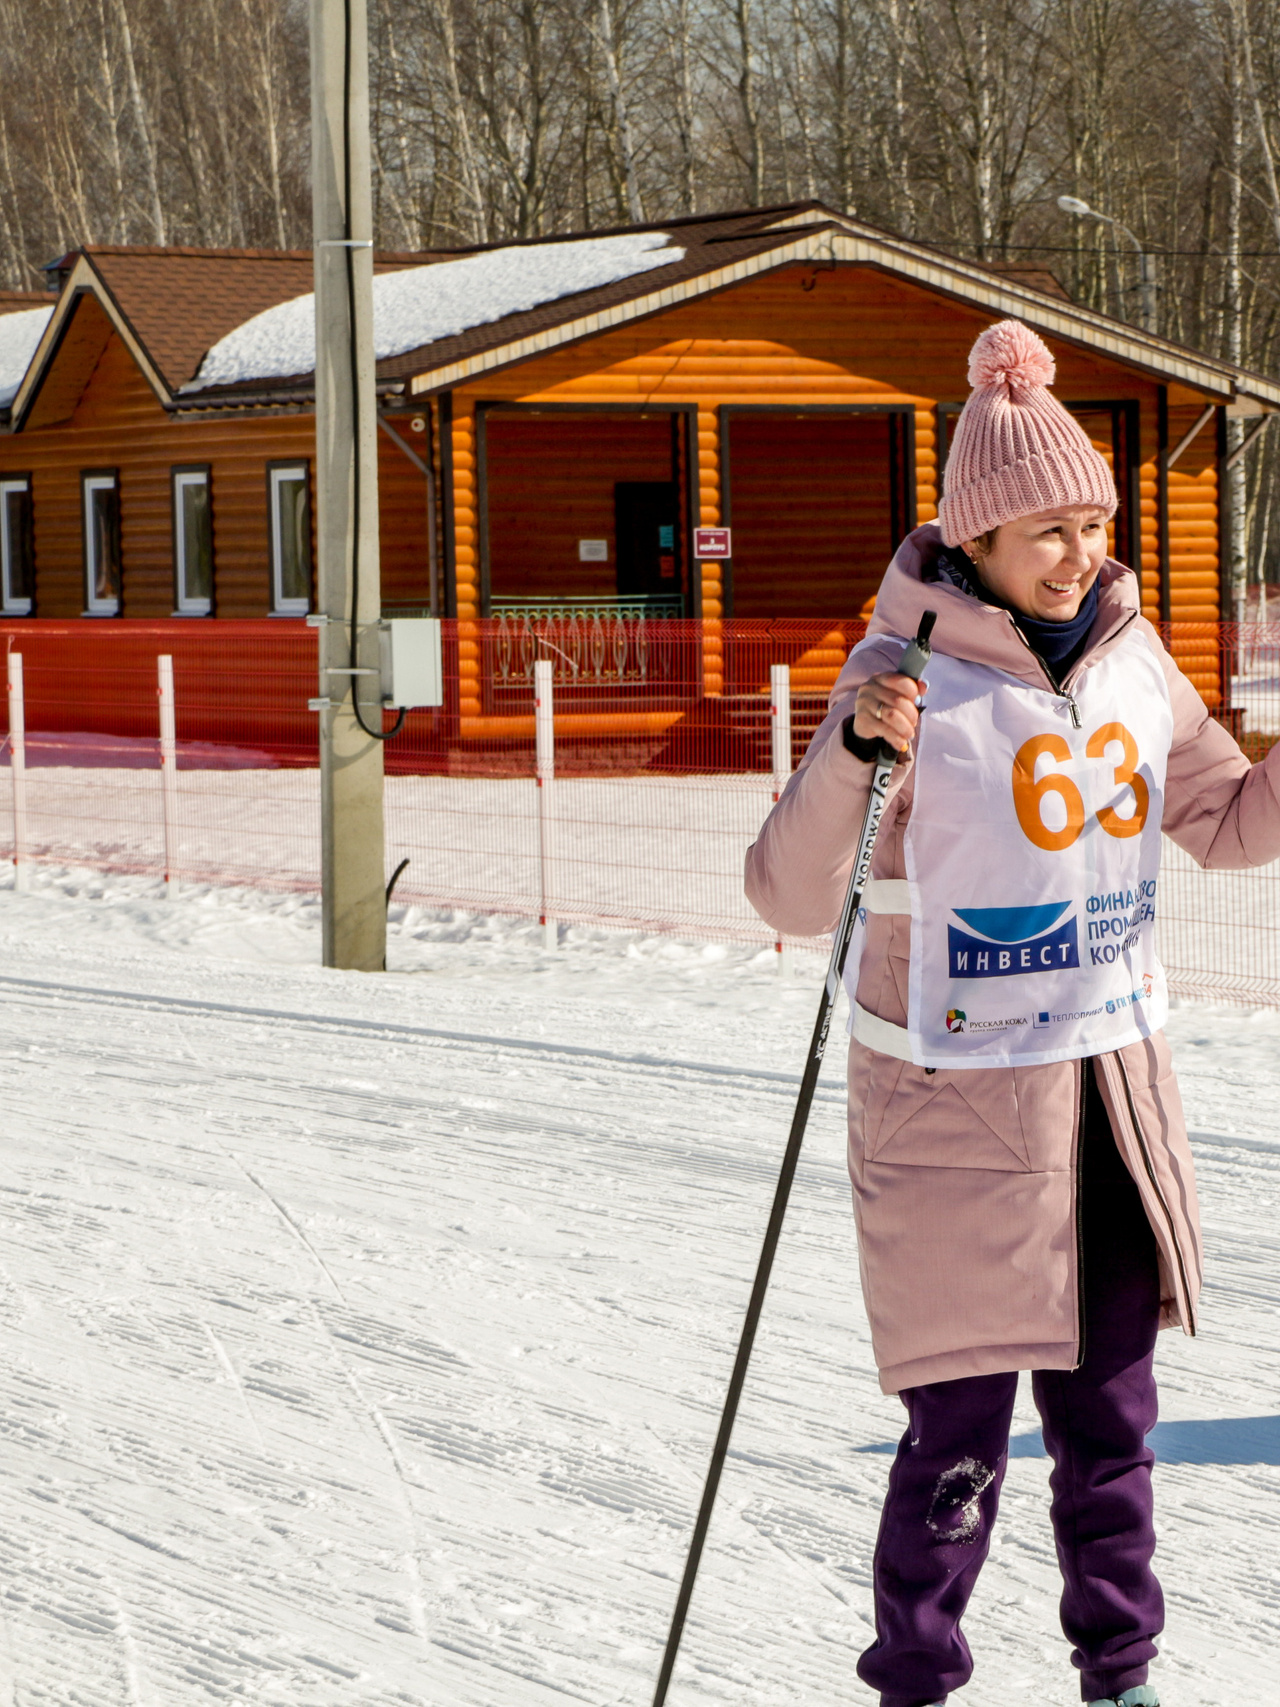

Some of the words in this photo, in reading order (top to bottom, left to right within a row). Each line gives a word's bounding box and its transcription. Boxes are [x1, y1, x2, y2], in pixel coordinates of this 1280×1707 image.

[1012, 721, 1150, 851] 63
[856, 802, 883, 887] NORDWAY
[956, 943, 1070, 971] ИНВЕСТ
[969, 1020, 1003, 1029] РУССКАЯ
[1005, 1017, 1028, 1026] КОЖА
[1052, 1006, 1104, 1023] ТЕПЛОПРИБОР
